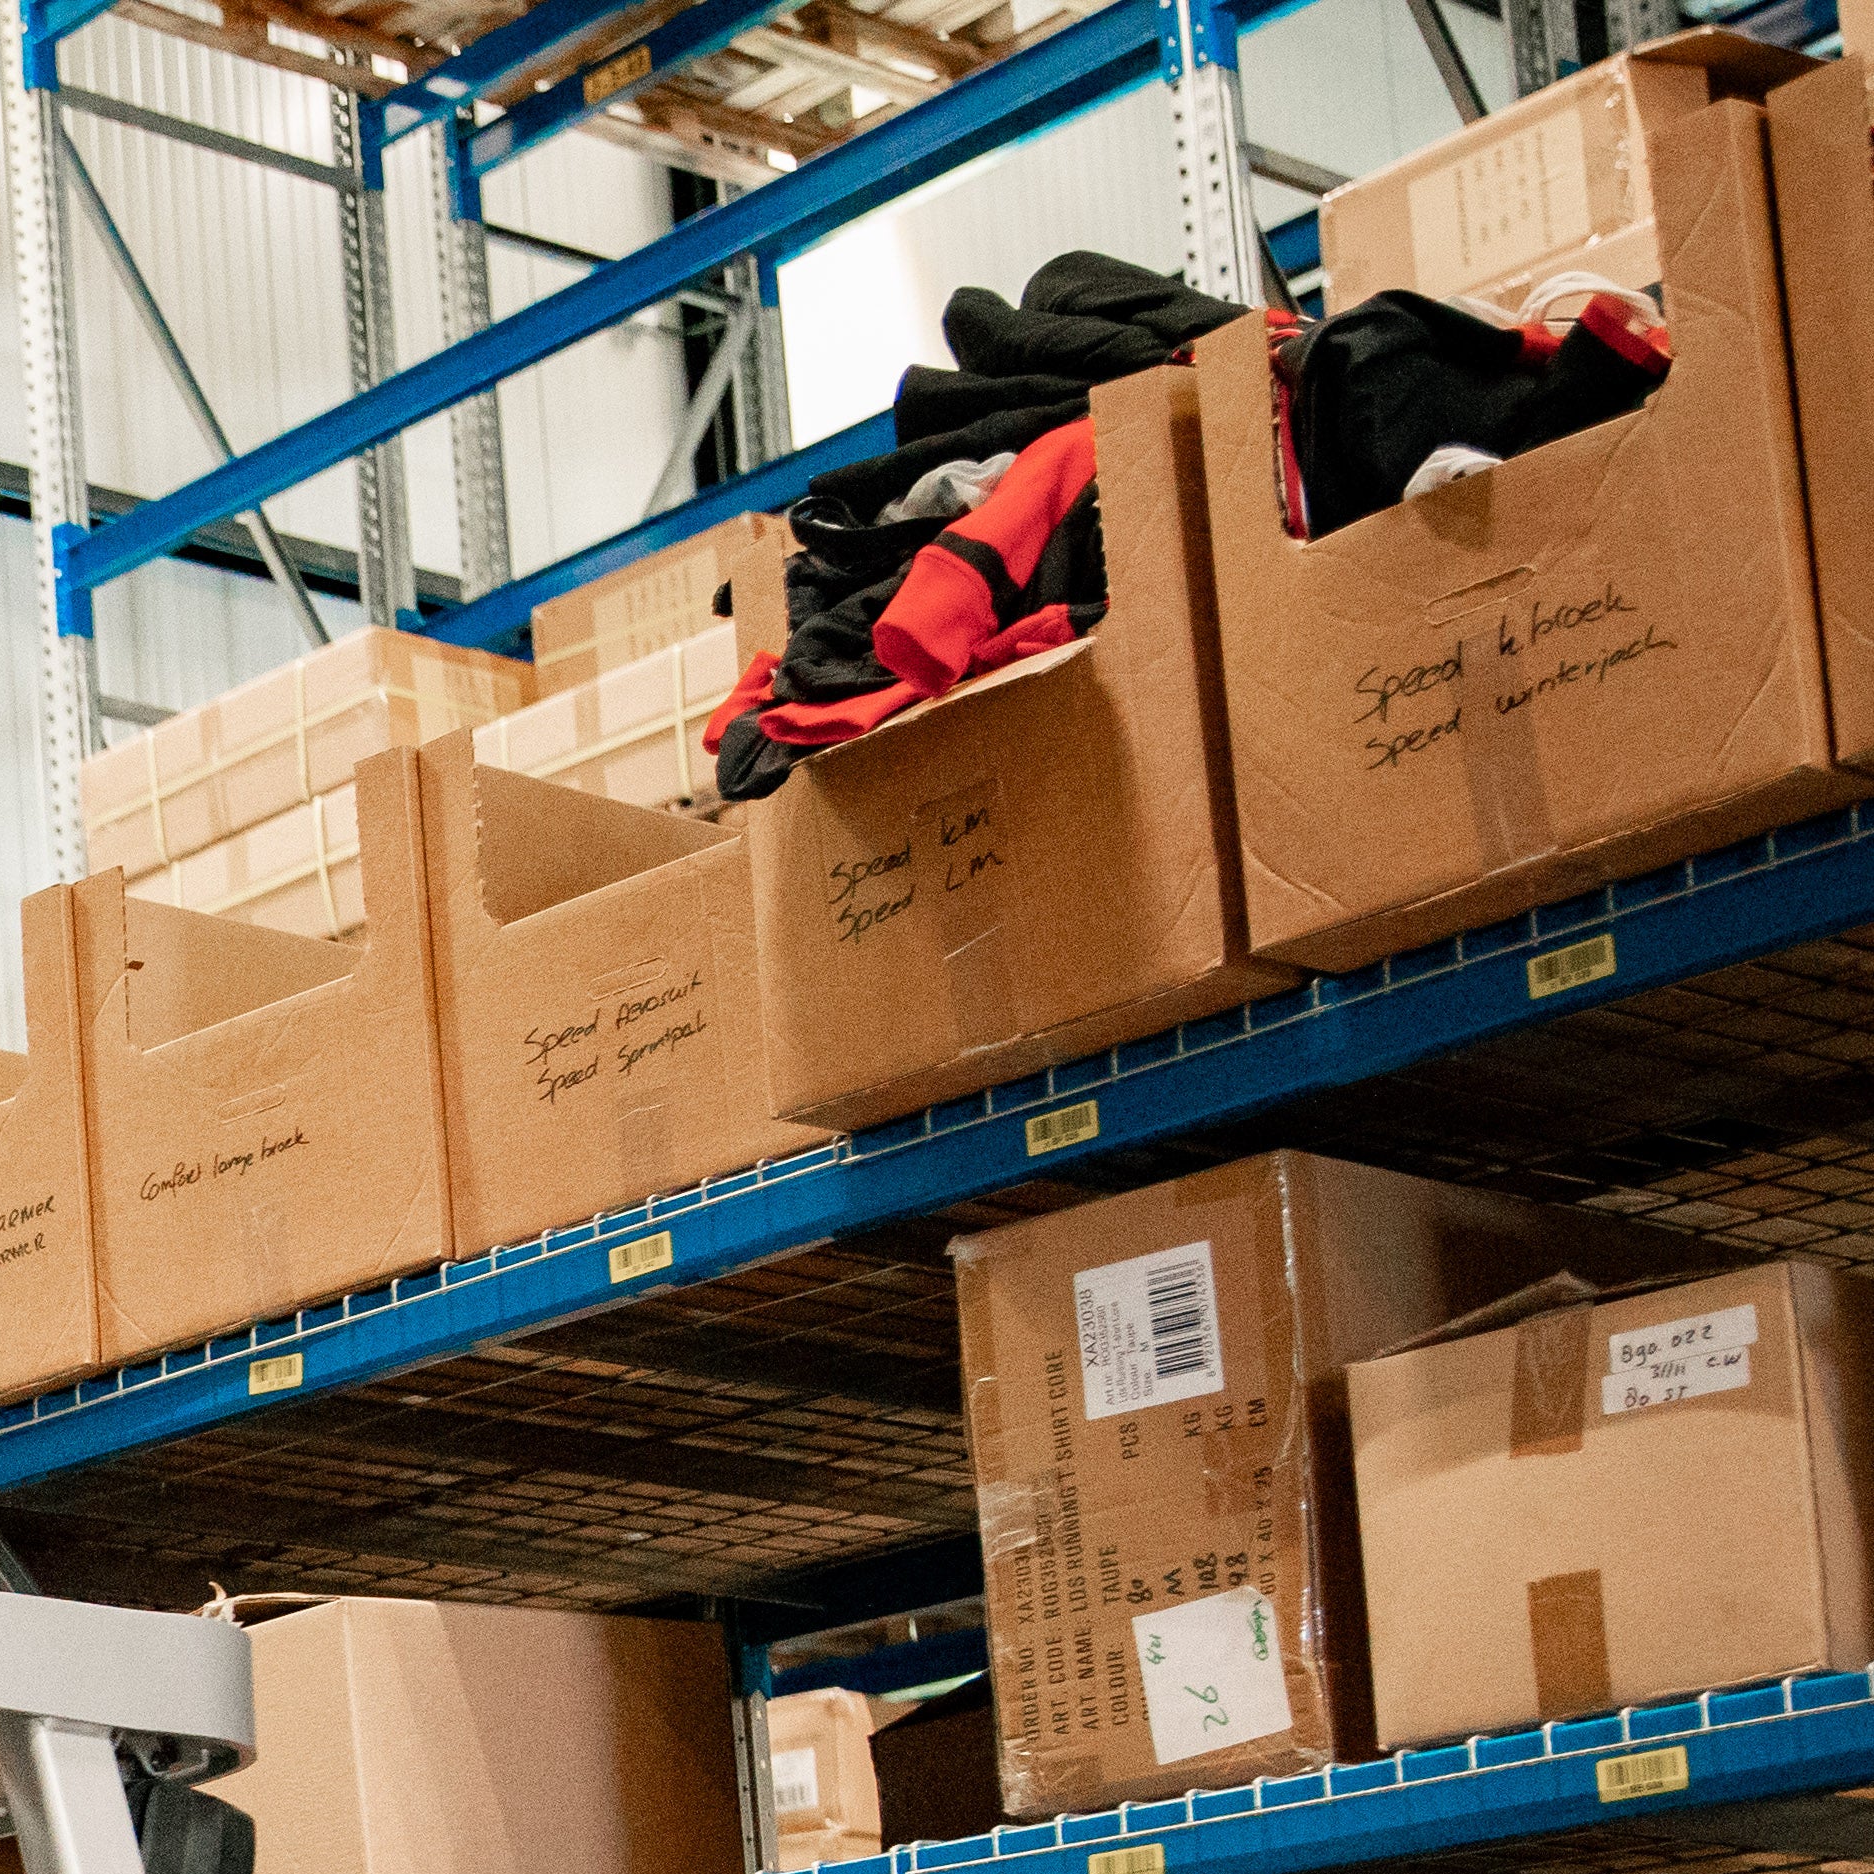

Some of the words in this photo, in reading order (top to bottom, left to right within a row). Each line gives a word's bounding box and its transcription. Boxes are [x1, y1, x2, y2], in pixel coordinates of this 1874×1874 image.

[1078, 1288, 1099, 1369] XA23038
[1044, 1348, 1067, 1401] CORE
[1120, 1421, 1141, 1461] PCS
[1182, 1410, 1201, 1438] KG
[1215, 1404, 1234, 1432] KG
[1056, 1486, 1084, 1570] RUNNING
[1253, 1517, 1274, 1543] 40
[1098, 1544, 1122, 1606] TAUPE
